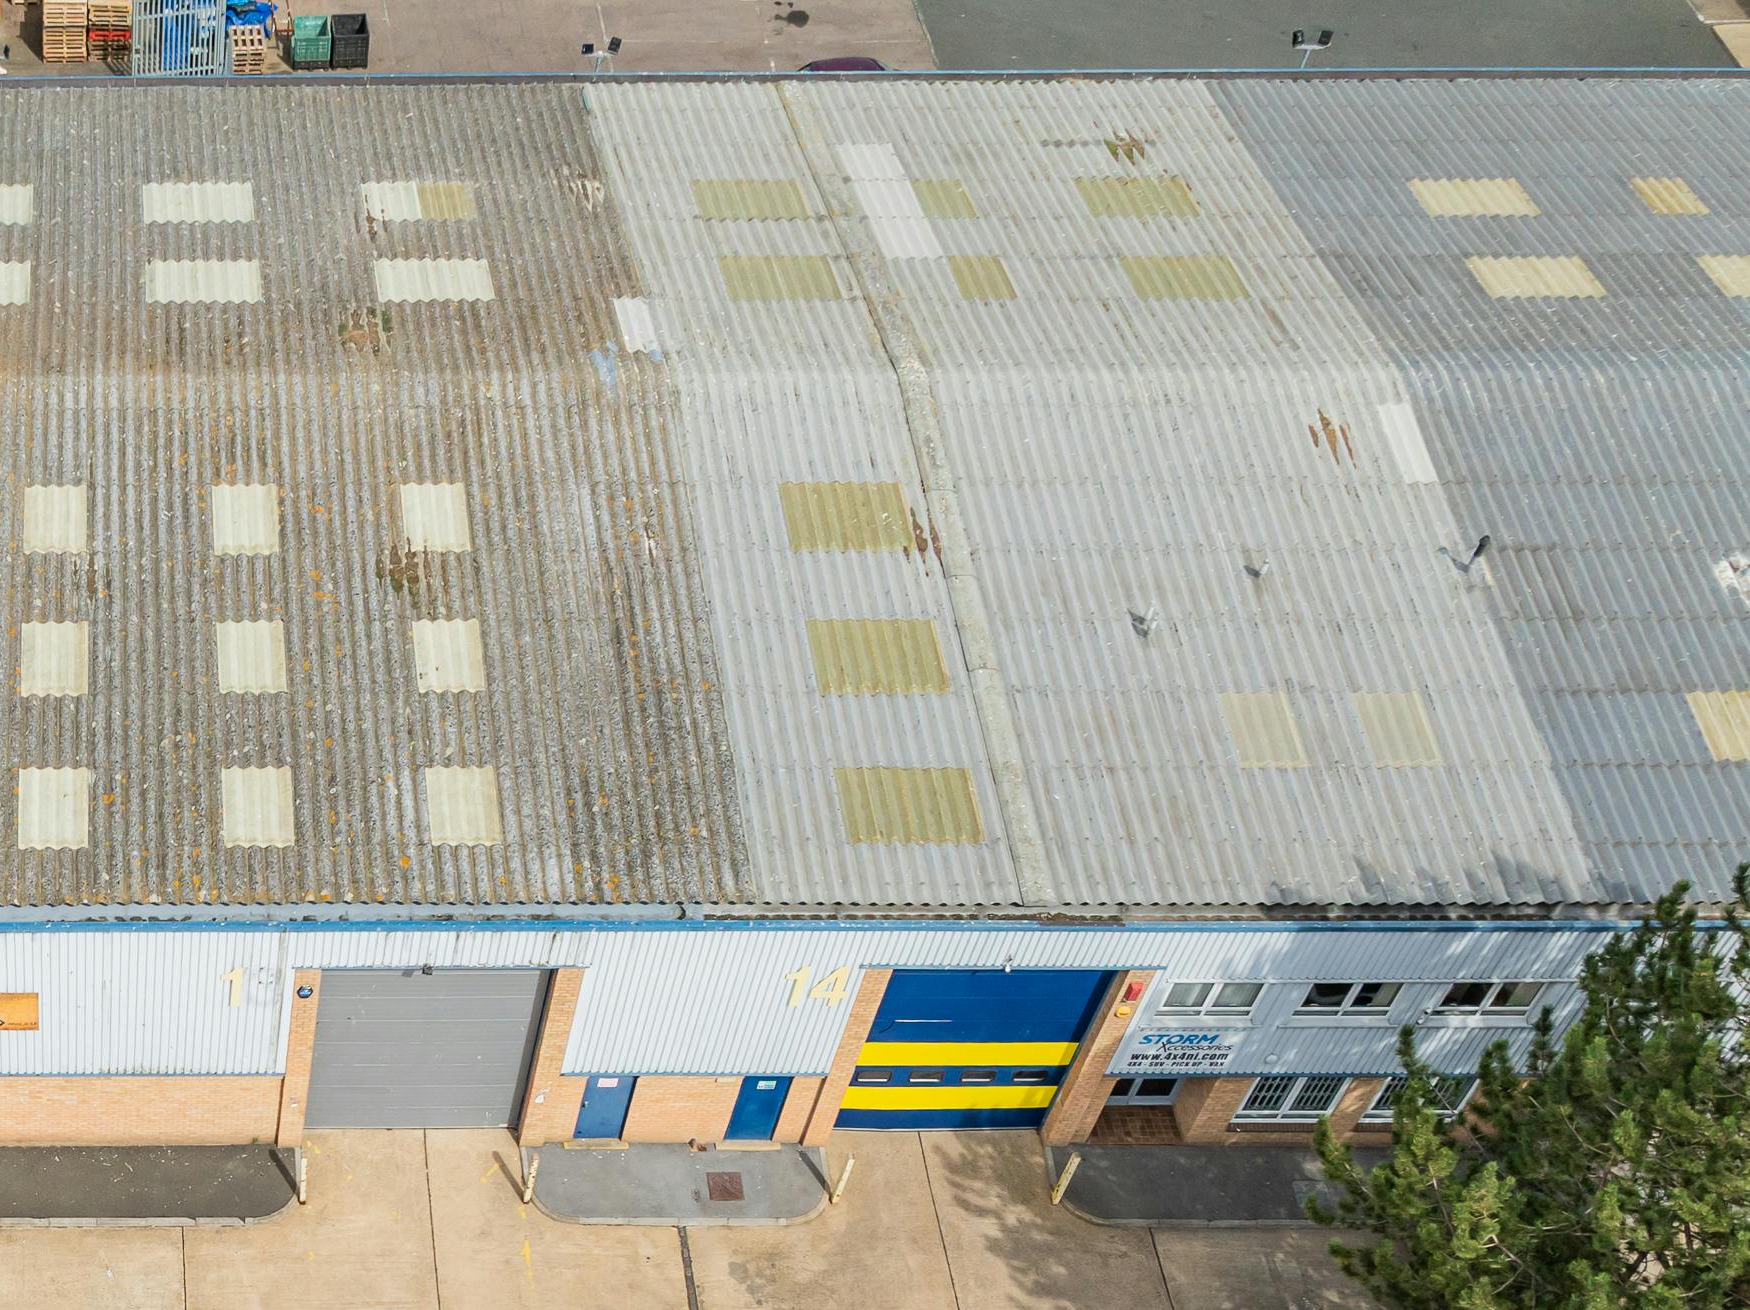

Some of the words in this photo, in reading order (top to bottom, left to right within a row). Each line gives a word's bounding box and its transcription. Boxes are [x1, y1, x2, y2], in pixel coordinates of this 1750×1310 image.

[784, 964, 850, 1009] 14
[1138, 1034, 1220, 1045] STORM
[1156, 1042, 1234, 1053] Xccessories
